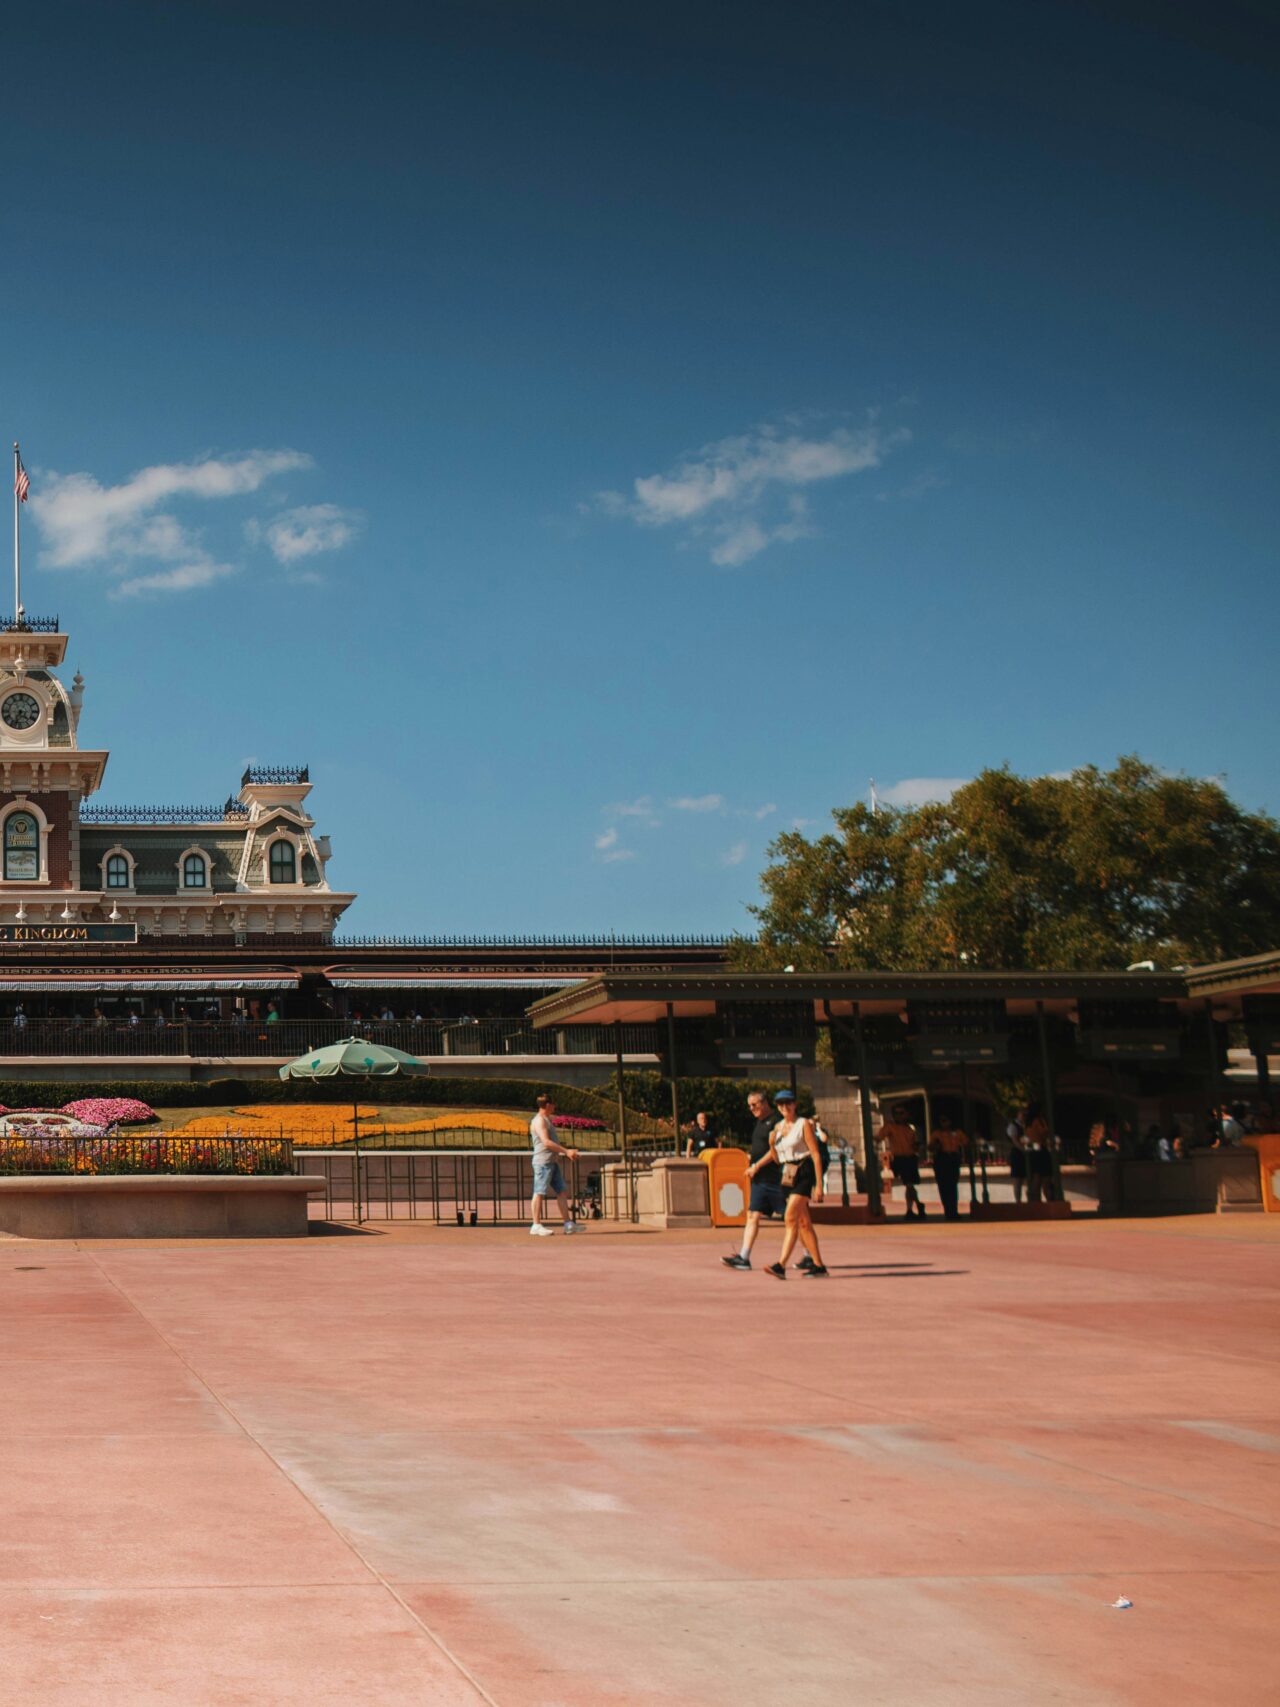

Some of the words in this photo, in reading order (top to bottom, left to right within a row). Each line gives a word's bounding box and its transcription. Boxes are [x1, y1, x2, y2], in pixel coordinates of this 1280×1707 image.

[14, 927, 88, 940] KINGDOM
[59, 967, 116, 975] WORLD
[121, 967, 203, 975] RAILROAD
